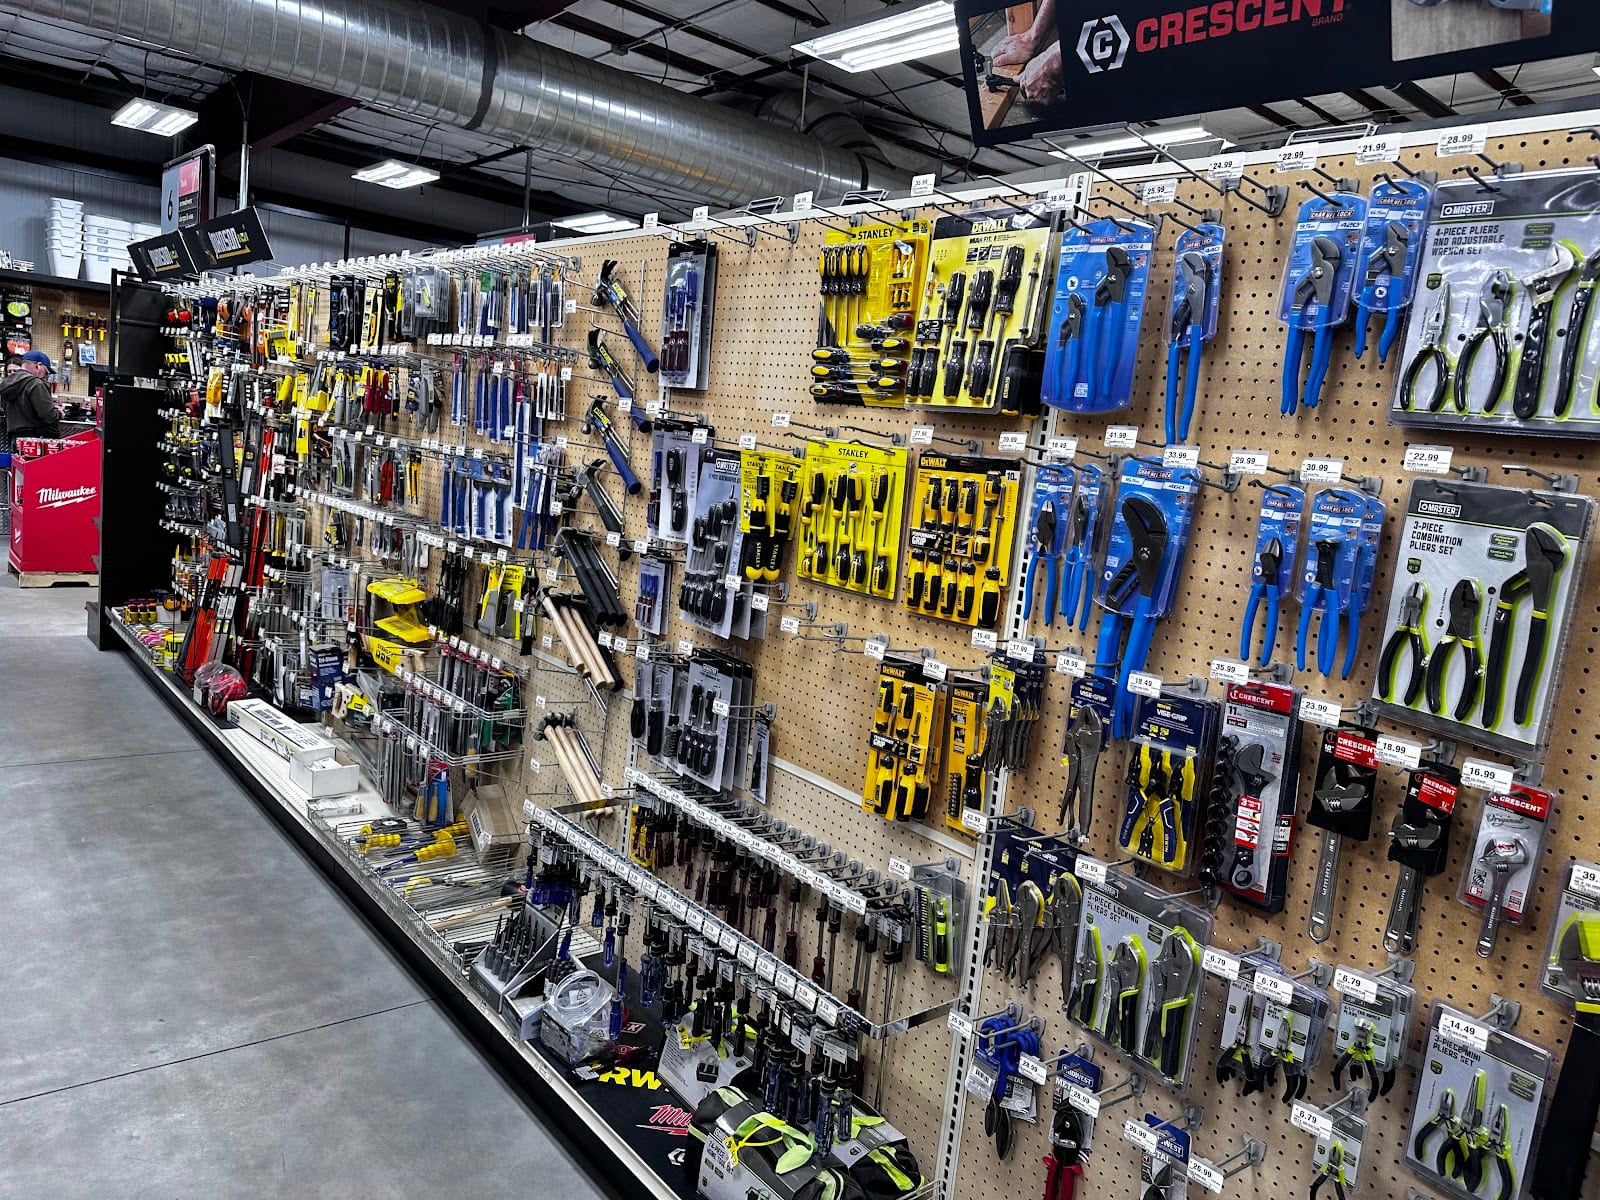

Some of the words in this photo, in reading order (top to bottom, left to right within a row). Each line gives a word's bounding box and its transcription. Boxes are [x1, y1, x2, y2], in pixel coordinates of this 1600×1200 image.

[1311, 13, 1344, 27] BRAND
[1447, 134, 1473, 144] 28.99
[1362, 142, 1387, 153] 21.99
[1282, 151, 1304, 161] 22.99
[1213, 161, 1233, 170] 24.99
[1147, 186, 1165, 195] 25.99
[167, 188, 173, 221] 6
[1452, 203, 1486, 215] MASTER
[858, 228, 894, 240] STANLEY
[1435, 226, 1467, 236] 4-PIECE
[1469, 225, 1499, 235] PLIERS
[1433, 237, 1449, 247] AND
[1451, 235, 1505, 245] ADJUSTABLE
[1468, 246, 1482, 256] SET
[838, 447, 869, 458] STANLEY
[1168, 451, 1187, 460] 33.99
[1413, 452, 1439, 462] 22.99
[1235, 456, 1256, 465] 29.99
[1306, 463, 1329, 472] 30.99
[35, 485, 97, 504] Milwaukee
[1427, 504, 1456, 515] MASTER
[1413, 521, 1444, 533] 3-PIECE
[911, 536, 927, 546] GRIP
[1411, 530, 1464, 547] COMBINATION
[1409, 541, 1436, 553] PLIERS
[1438, 545, 1454, 556] SET
[770, 544, 779, 570] STANLEY
[1215, 663, 1236, 674] 35.99
[1238, 692, 1275, 706] CRESCENT
[1305, 701, 1328, 713] 23.99
[1338, 736, 1376, 753] CRESCEN
[1382, 742, 1406, 754] 18.99
[1469, 767, 1496, 780] 16.99
[1423, 777, 1456, 796] CRESCENT
[1500, 795, 1542, 813] CRESCENT
[1486, 812, 1525, 828] Original
[1087, 892, 1112, 910] 3-PIECE
[1113, 906, 1139, 924] LOCKING
[1087, 900, 1108, 917] PLIERS
[1109, 914, 1122, 925] SET
[1210, 955, 1226, 966] 6.79
[1261, 977, 1278, 989] 6.79
[1342, 975, 1361, 987] 6.79
[1449, 1020, 1476, 1035] 14.49
[1434, 1034, 1462, 1052] 3-PIECE
[1464, 1049, 1481, 1062] MINI
[1433, 1042, 1458, 1060] PLIERS
[1459, 1055, 1475, 1067] SET
[1299, 1110, 1317, 1124] 6.79
